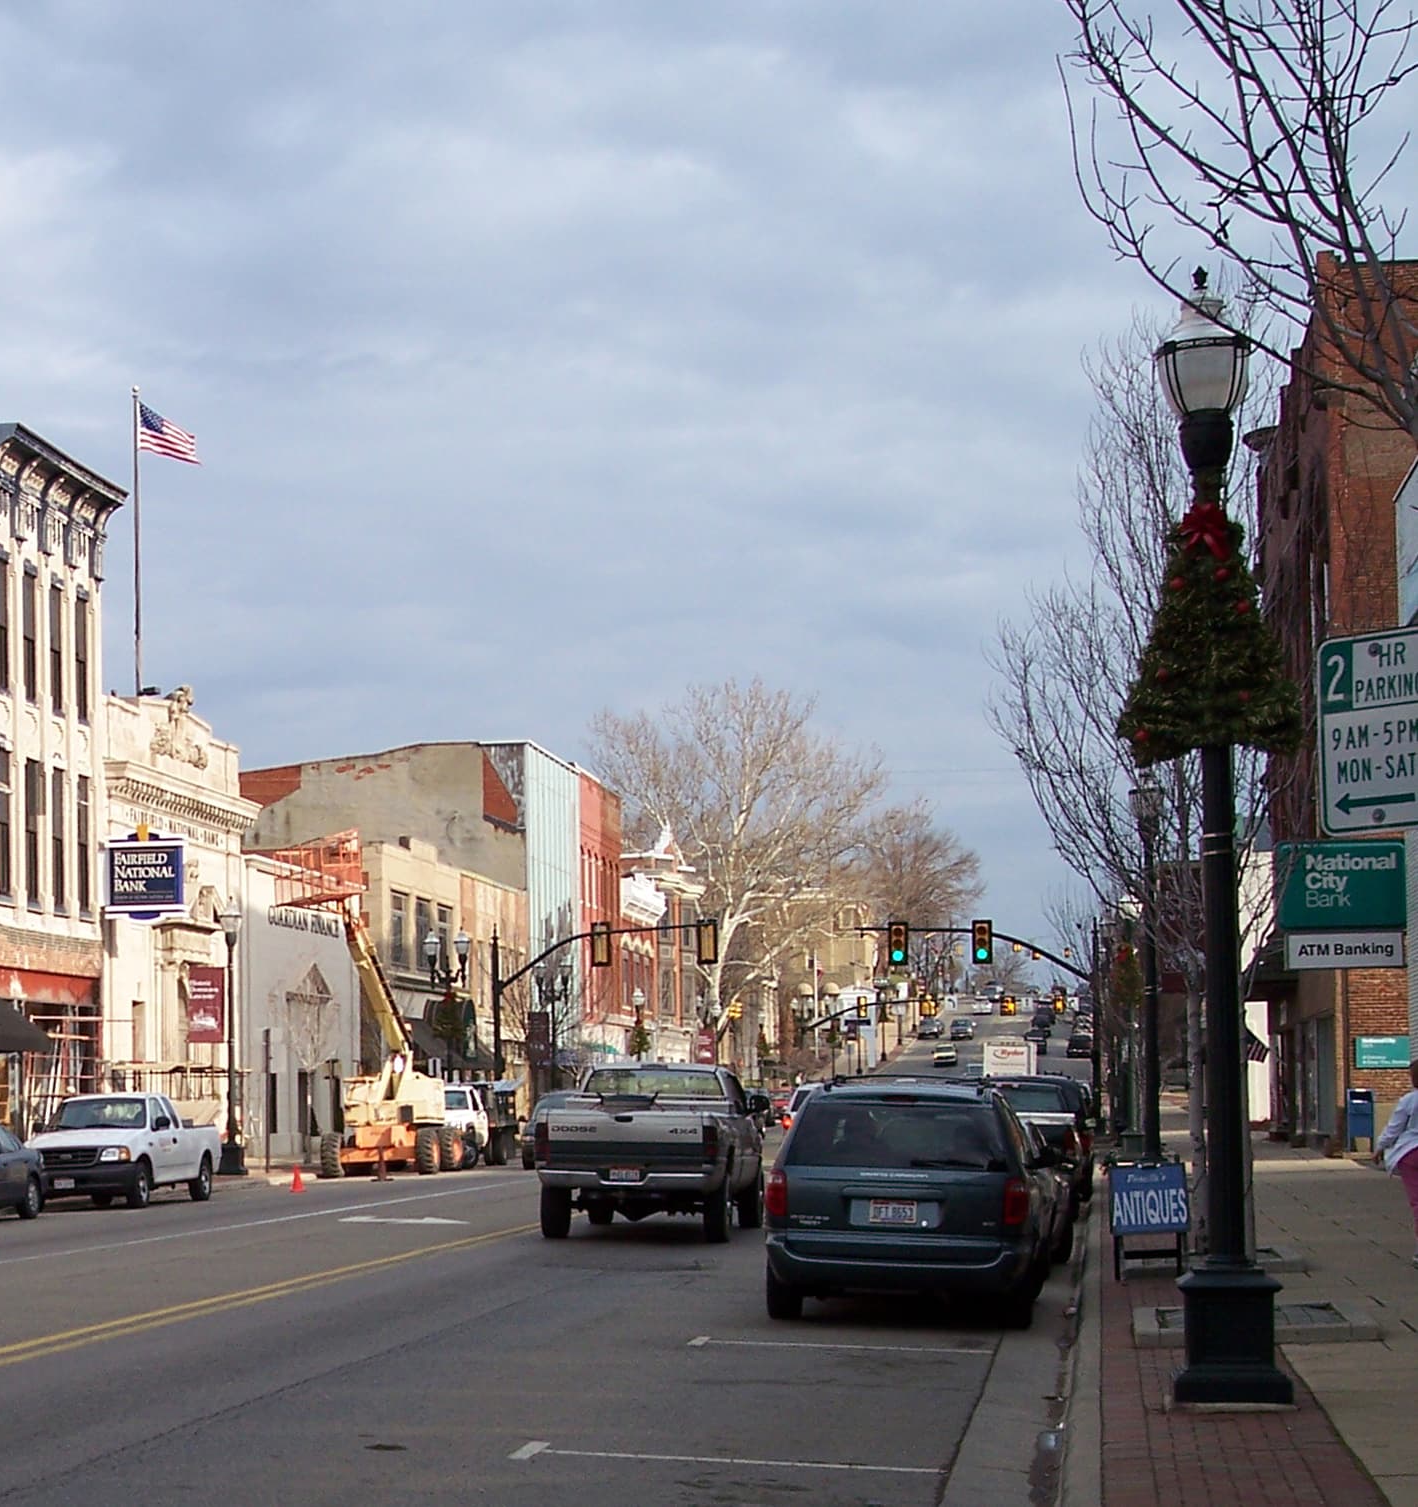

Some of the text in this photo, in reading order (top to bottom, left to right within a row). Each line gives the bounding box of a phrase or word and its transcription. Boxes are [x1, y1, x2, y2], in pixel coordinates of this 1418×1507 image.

[1326, 642, 1406, 702] 2 HR
[113, 852, 168, 866] FAIRFIELD
[1305, 852, 1397, 872] National
[113, 865, 176, 879] NATIONAL
[113, 878, 148, 893] BANK
[1305, 871, 1349, 893] City
[1305, 890, 1351, 908] Bank
[267, 905, 340, 939] GUARDIAN FINANCE
[1298, 943, 1395, 957] ATM Banking
[551, 1124, 598, 1133] DODGE
[1112, 1187, 1188, 1227] ANTIQUES
